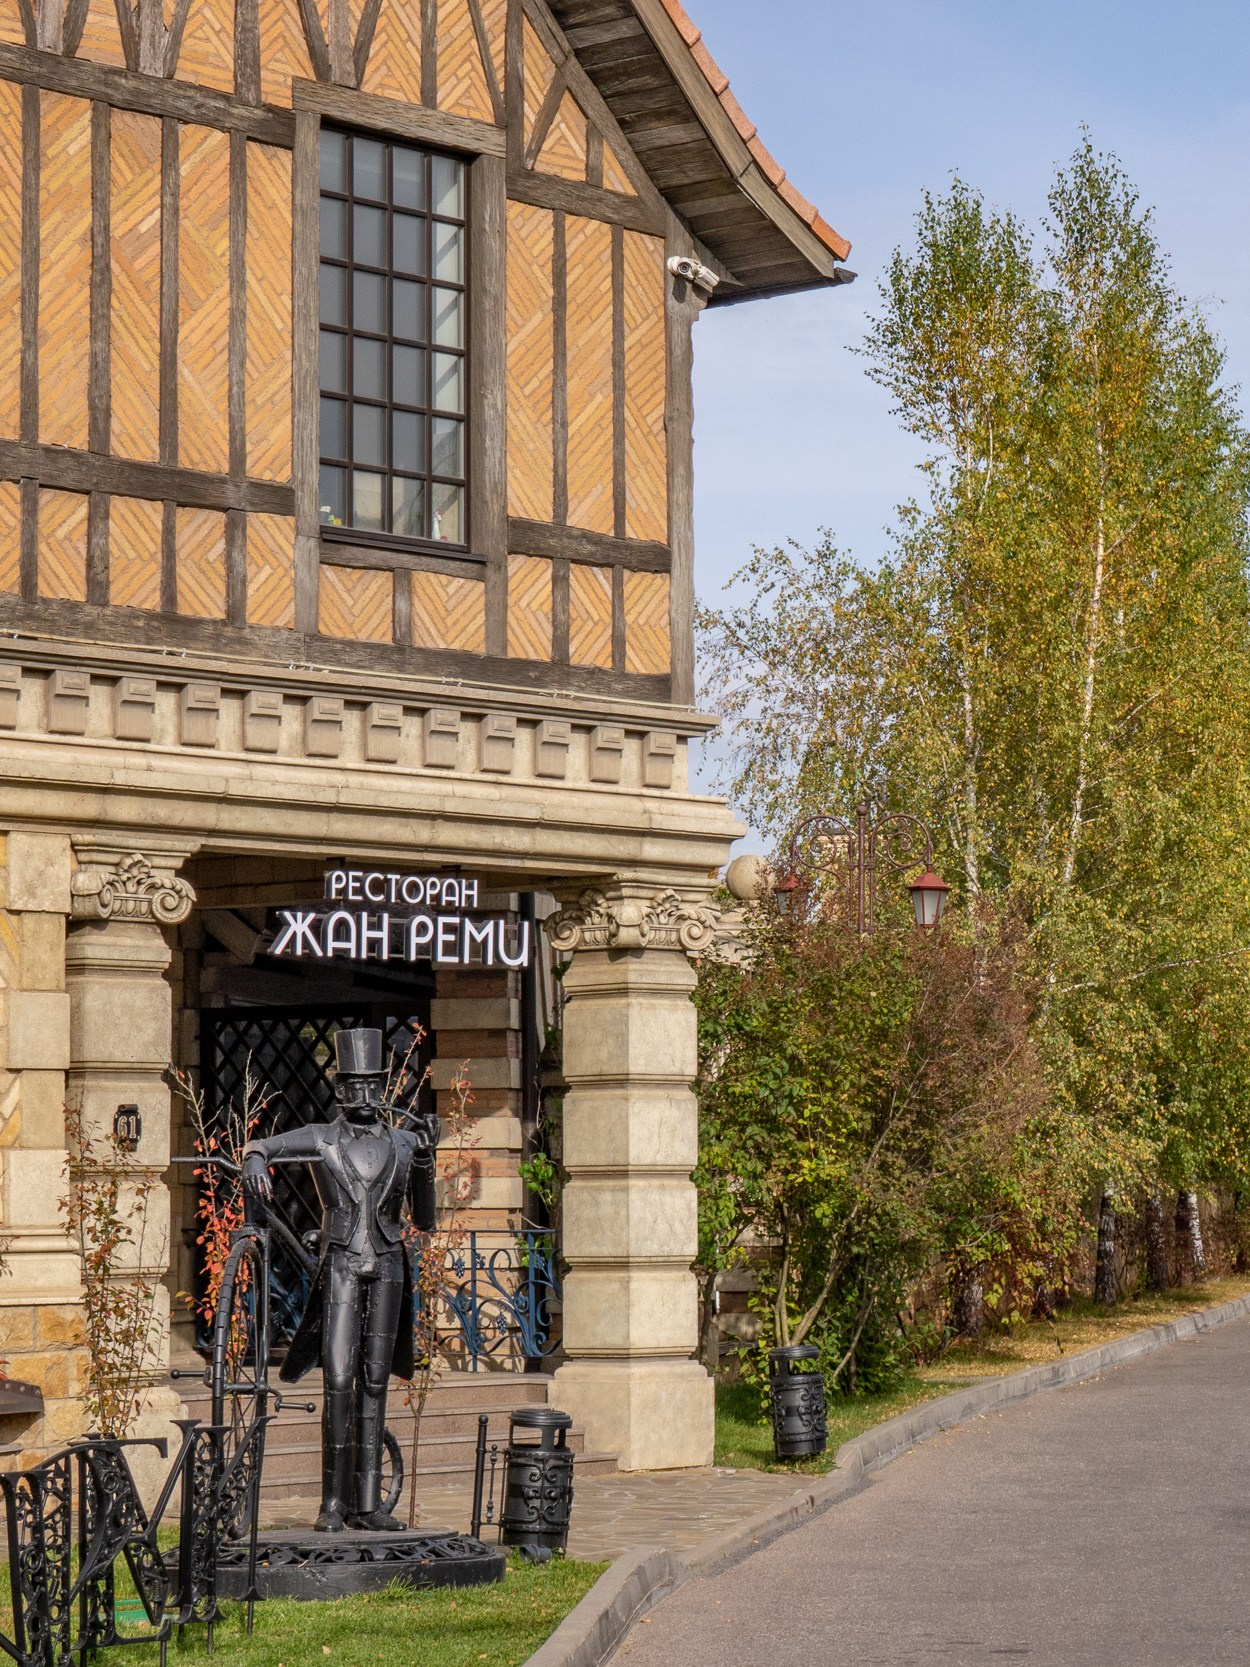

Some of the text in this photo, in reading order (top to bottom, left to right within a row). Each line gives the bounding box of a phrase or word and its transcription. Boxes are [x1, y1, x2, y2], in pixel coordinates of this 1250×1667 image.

[329, 870, 478, 908] РЕСТОРАН
[273, 910, 529, 967] ЖАН РЕМИ
[117, 1115, 137, 1139] 61
